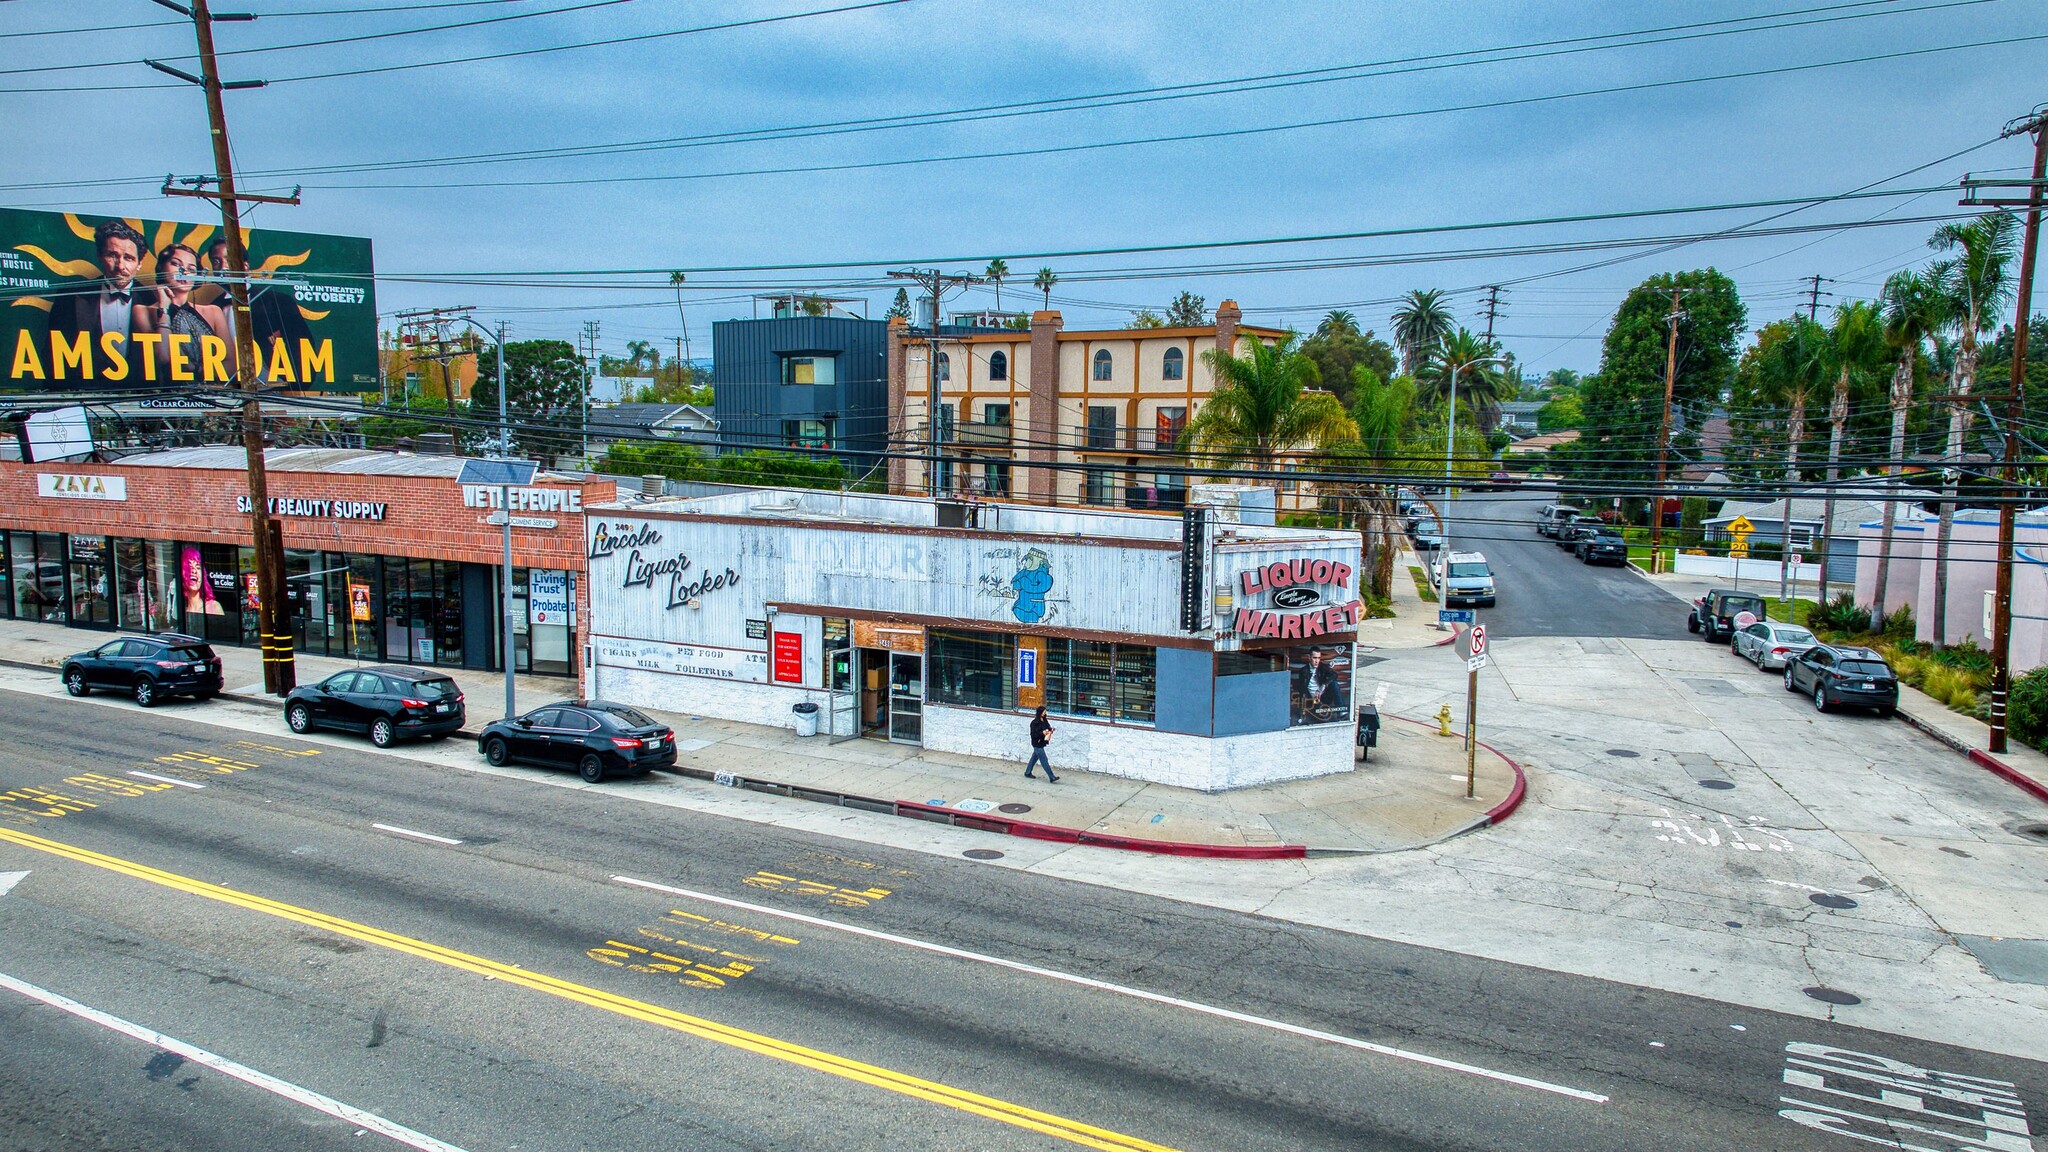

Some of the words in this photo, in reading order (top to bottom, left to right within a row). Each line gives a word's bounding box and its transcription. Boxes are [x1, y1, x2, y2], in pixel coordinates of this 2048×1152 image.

[3, 260, 34, 270] HUSTLE
[9, 278, 49, 288] PLAYBOOK
[325, 286, 365, 294] THEATERS
[294, 291, 355, 304] OCTOBER
[357, 294, 365, 304] 7
[52, 475, 106, 494] ZAYA
[462, 485, 488, 508] WE
[518, 487, 582, 513] PEOPLE
[236, 495, 274, 514] SAY
[278, 497, 331, 517] BEAUTY
[334, 500, 386, 520] SUPPLY
[507, 517, 532, 526] OCUMENT
[532, 518, 553, 527] SERVICE
[589, 522, 663, 560] Lincoln
[209, 572, 234, 580] Celebrate
[623, 550, 691, 589] Liquor
[1241, 558, 1352, 596] LIQUOR
[534, 573, 566, 587] Living
[532, 584, 560, 594] Trust
[666, 568, 740, 610] Locker
[532, 598, 567, 612] Probate
[1233, 600, 1361, 639] MARKET
[602, 648, 638, 658] CIGARS
[677, 647, 696, 656] PET
[700, 650, 724, 659] FOOD
[745, 654, 766, 663] ATM
[637, 660, 660, 669] MILK
[676, 663, 734, 678] TOILETRIES
